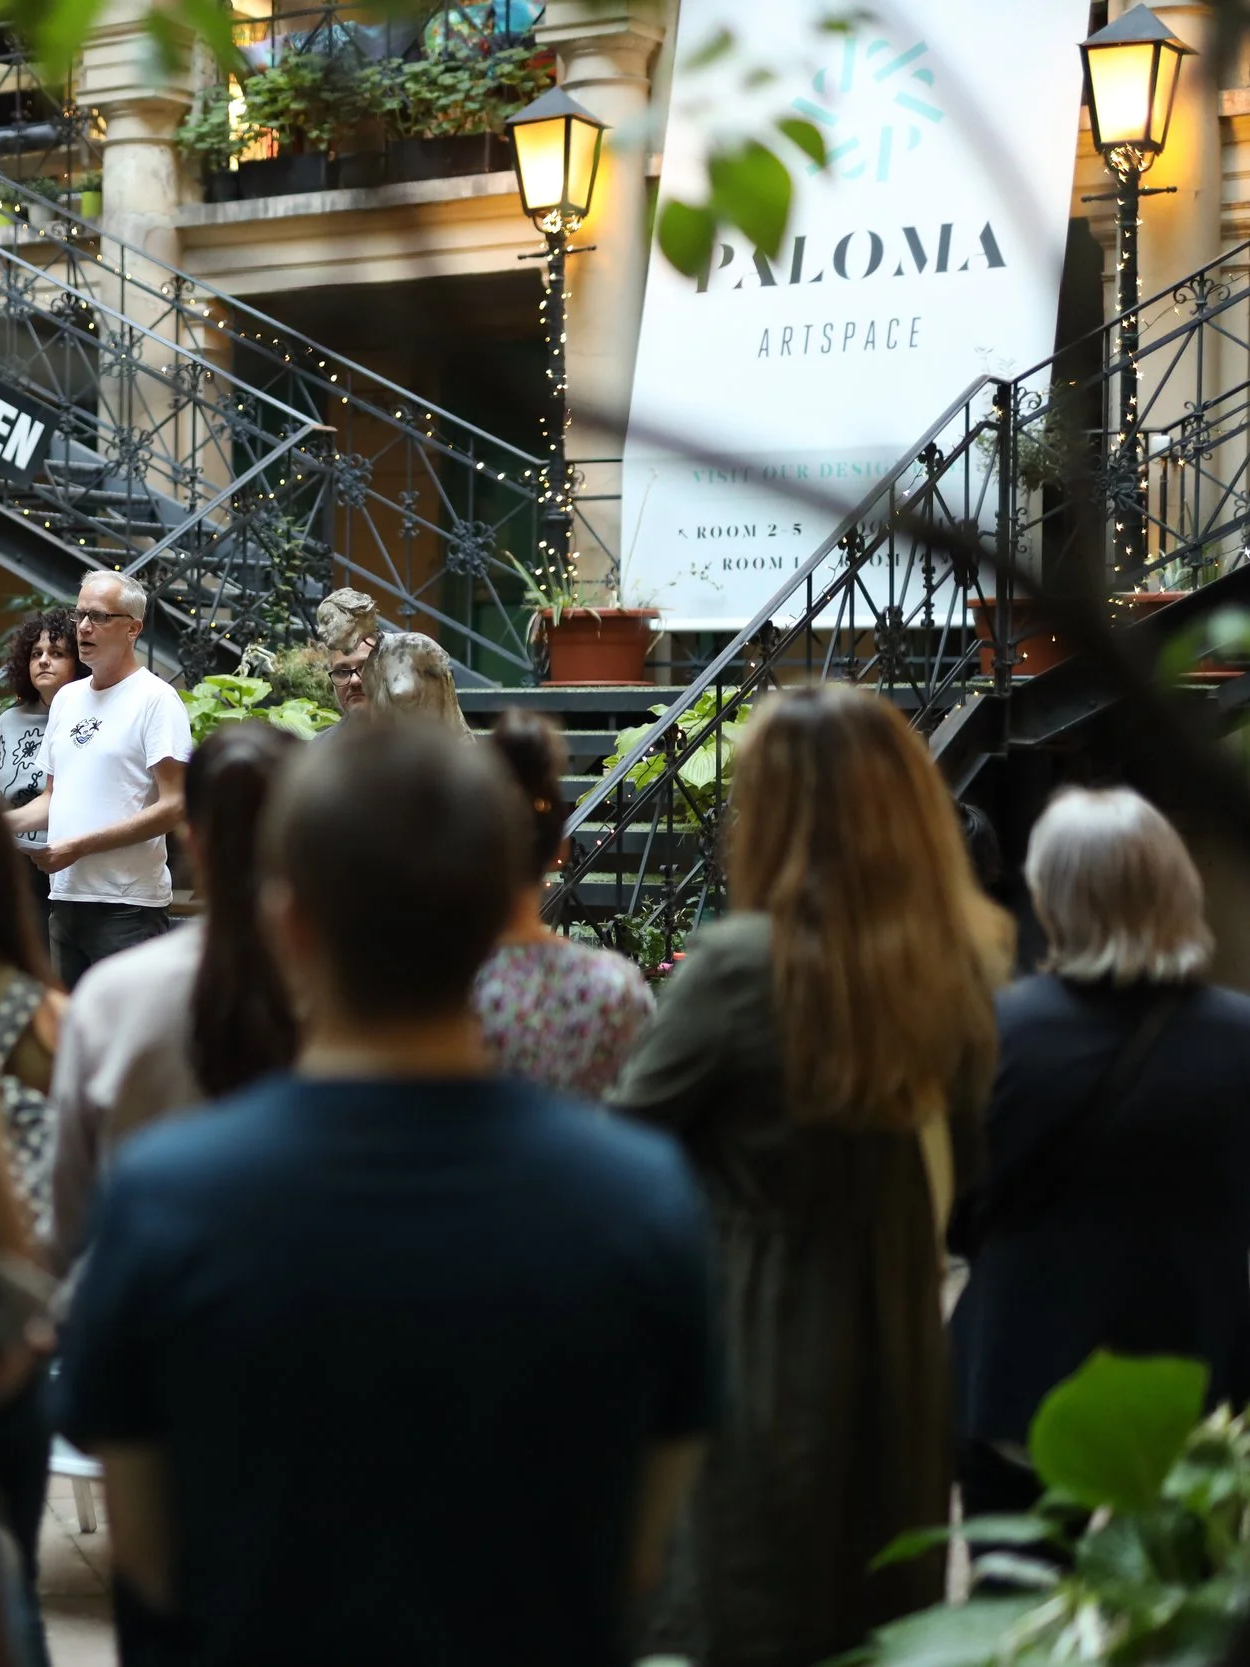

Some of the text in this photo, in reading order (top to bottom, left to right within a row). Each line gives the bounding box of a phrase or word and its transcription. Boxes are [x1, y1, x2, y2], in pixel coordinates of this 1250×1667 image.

[696, 221, 1007, 293] PALOMA
[757, 316, 922, 358] ARTSPACE
[693, 466, 752, 484] VISIT
[762, 463, 809, 480] OUR
[697, 524, 756, 539] ROOM
[723, 556, 782, 571] ROOM
